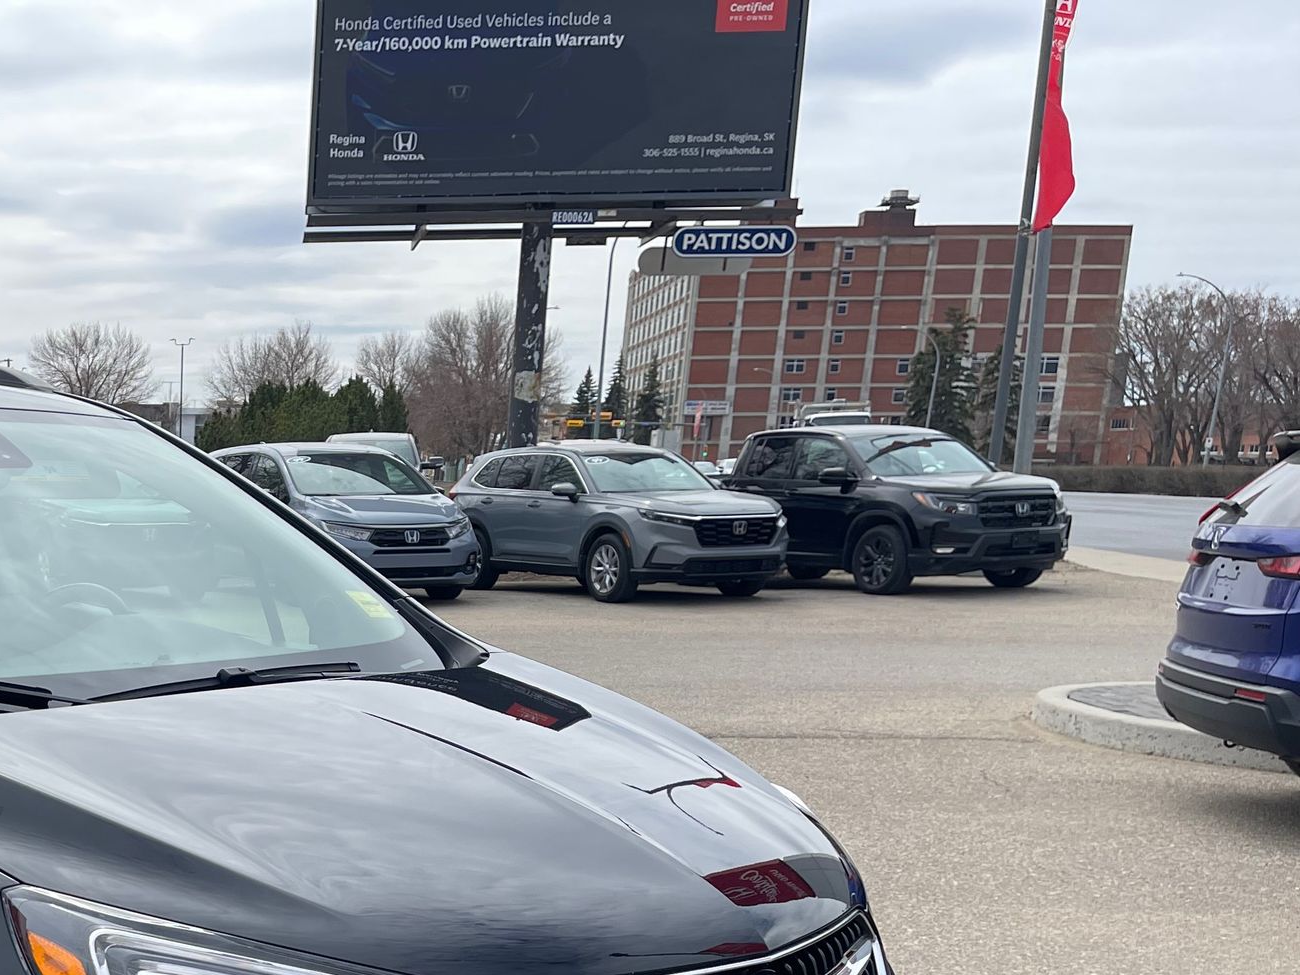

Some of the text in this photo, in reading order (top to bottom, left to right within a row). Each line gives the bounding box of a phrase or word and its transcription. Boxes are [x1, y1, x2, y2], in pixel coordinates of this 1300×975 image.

[730, 2, 774, 14] Certified
[334, 11, 612, 31] Honda Certified Used Vehicles include a
[334, 32, 625, 53] 7-Year/160,000 km Powertrain Warranty
[329, 133, 366, 146] Regina
[687, 133, 714, 143] Broad
[763, 132, 776, 142] SK
[330, 147, 364, 158] Honda
[383, 153, 426, 161] HONDA
[642, 147, 700, 158] 306-525-1555
[706, 146, 774, 158] reginahonda.ca
[552, 211, 594, 223] RE00062A
[682, 232, 788, 250] PATTISON
